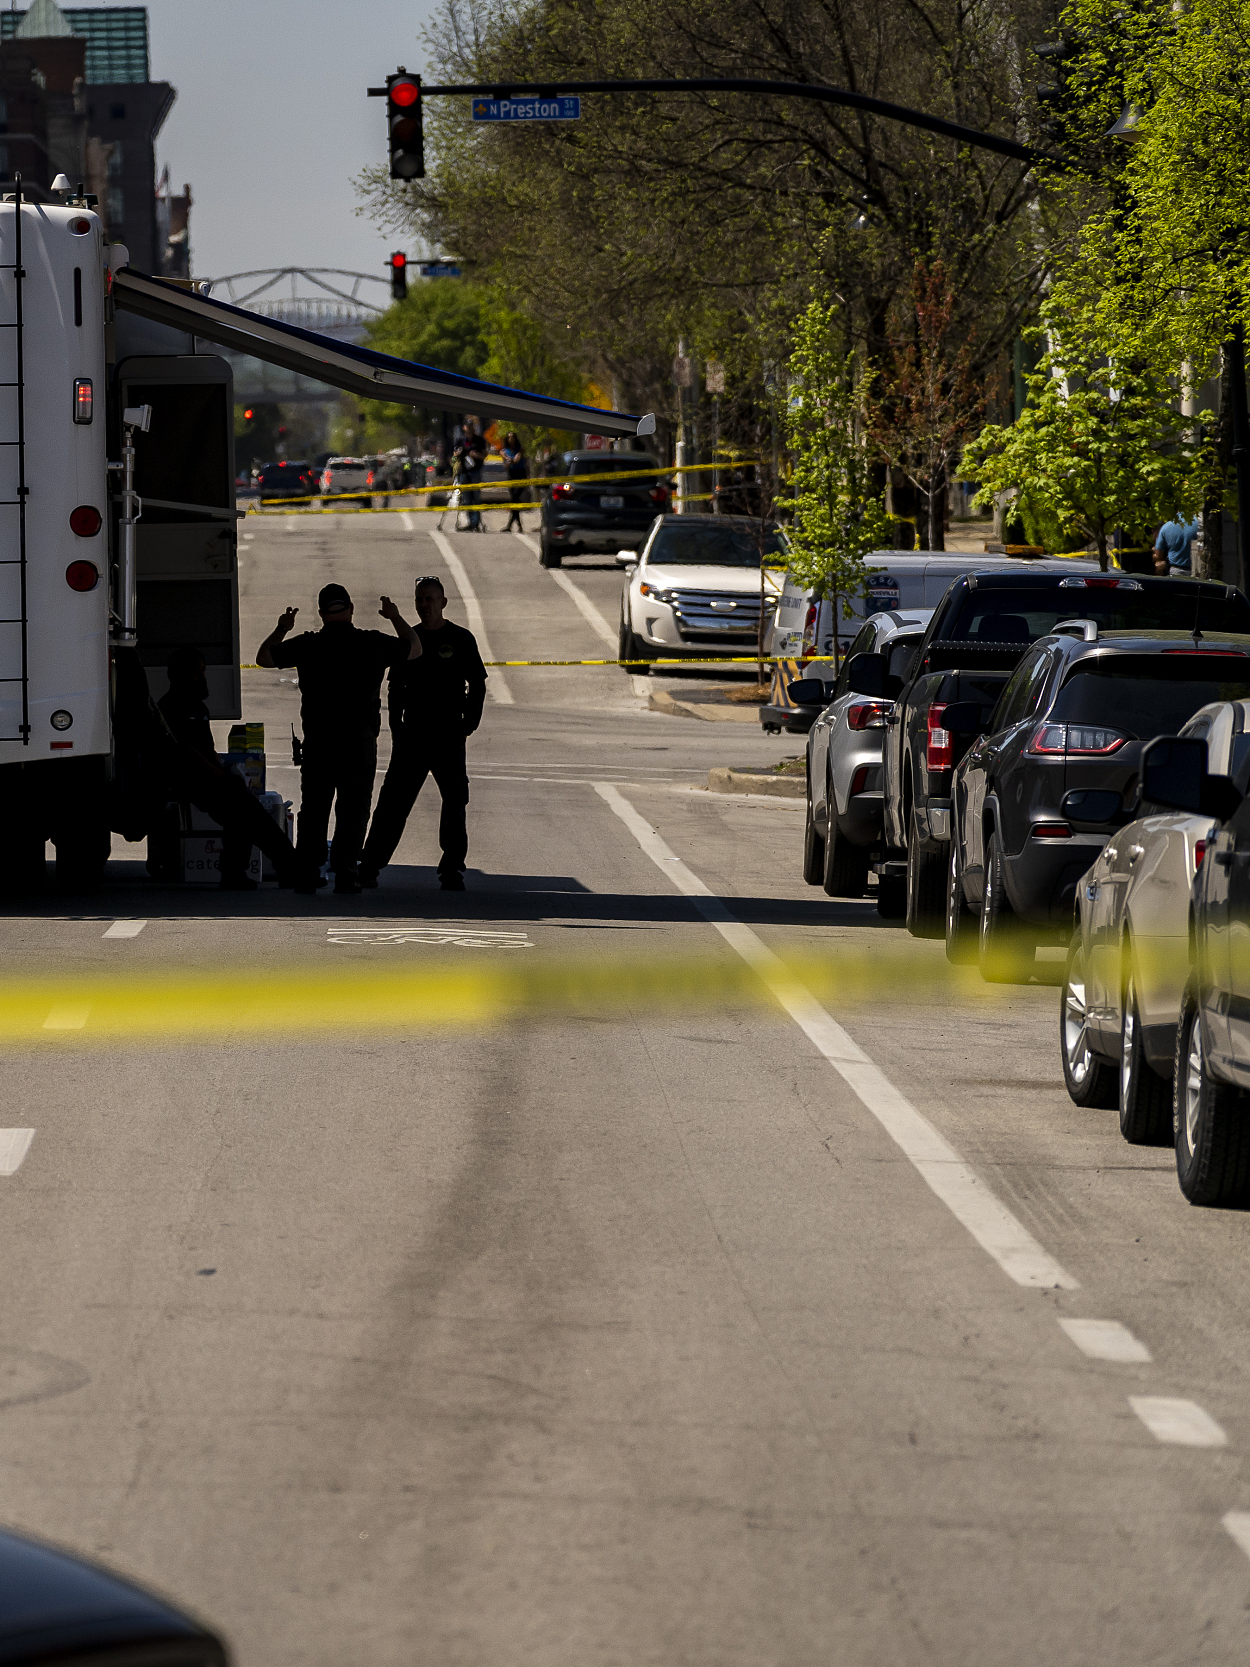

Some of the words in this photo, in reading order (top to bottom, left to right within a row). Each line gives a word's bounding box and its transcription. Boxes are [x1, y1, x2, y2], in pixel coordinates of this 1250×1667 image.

[490, 104, 497, 115] N
[500, 101, 559, 118] Preston
[564, 99, 574, 108] St
[186, 858, 259, 874] categ
